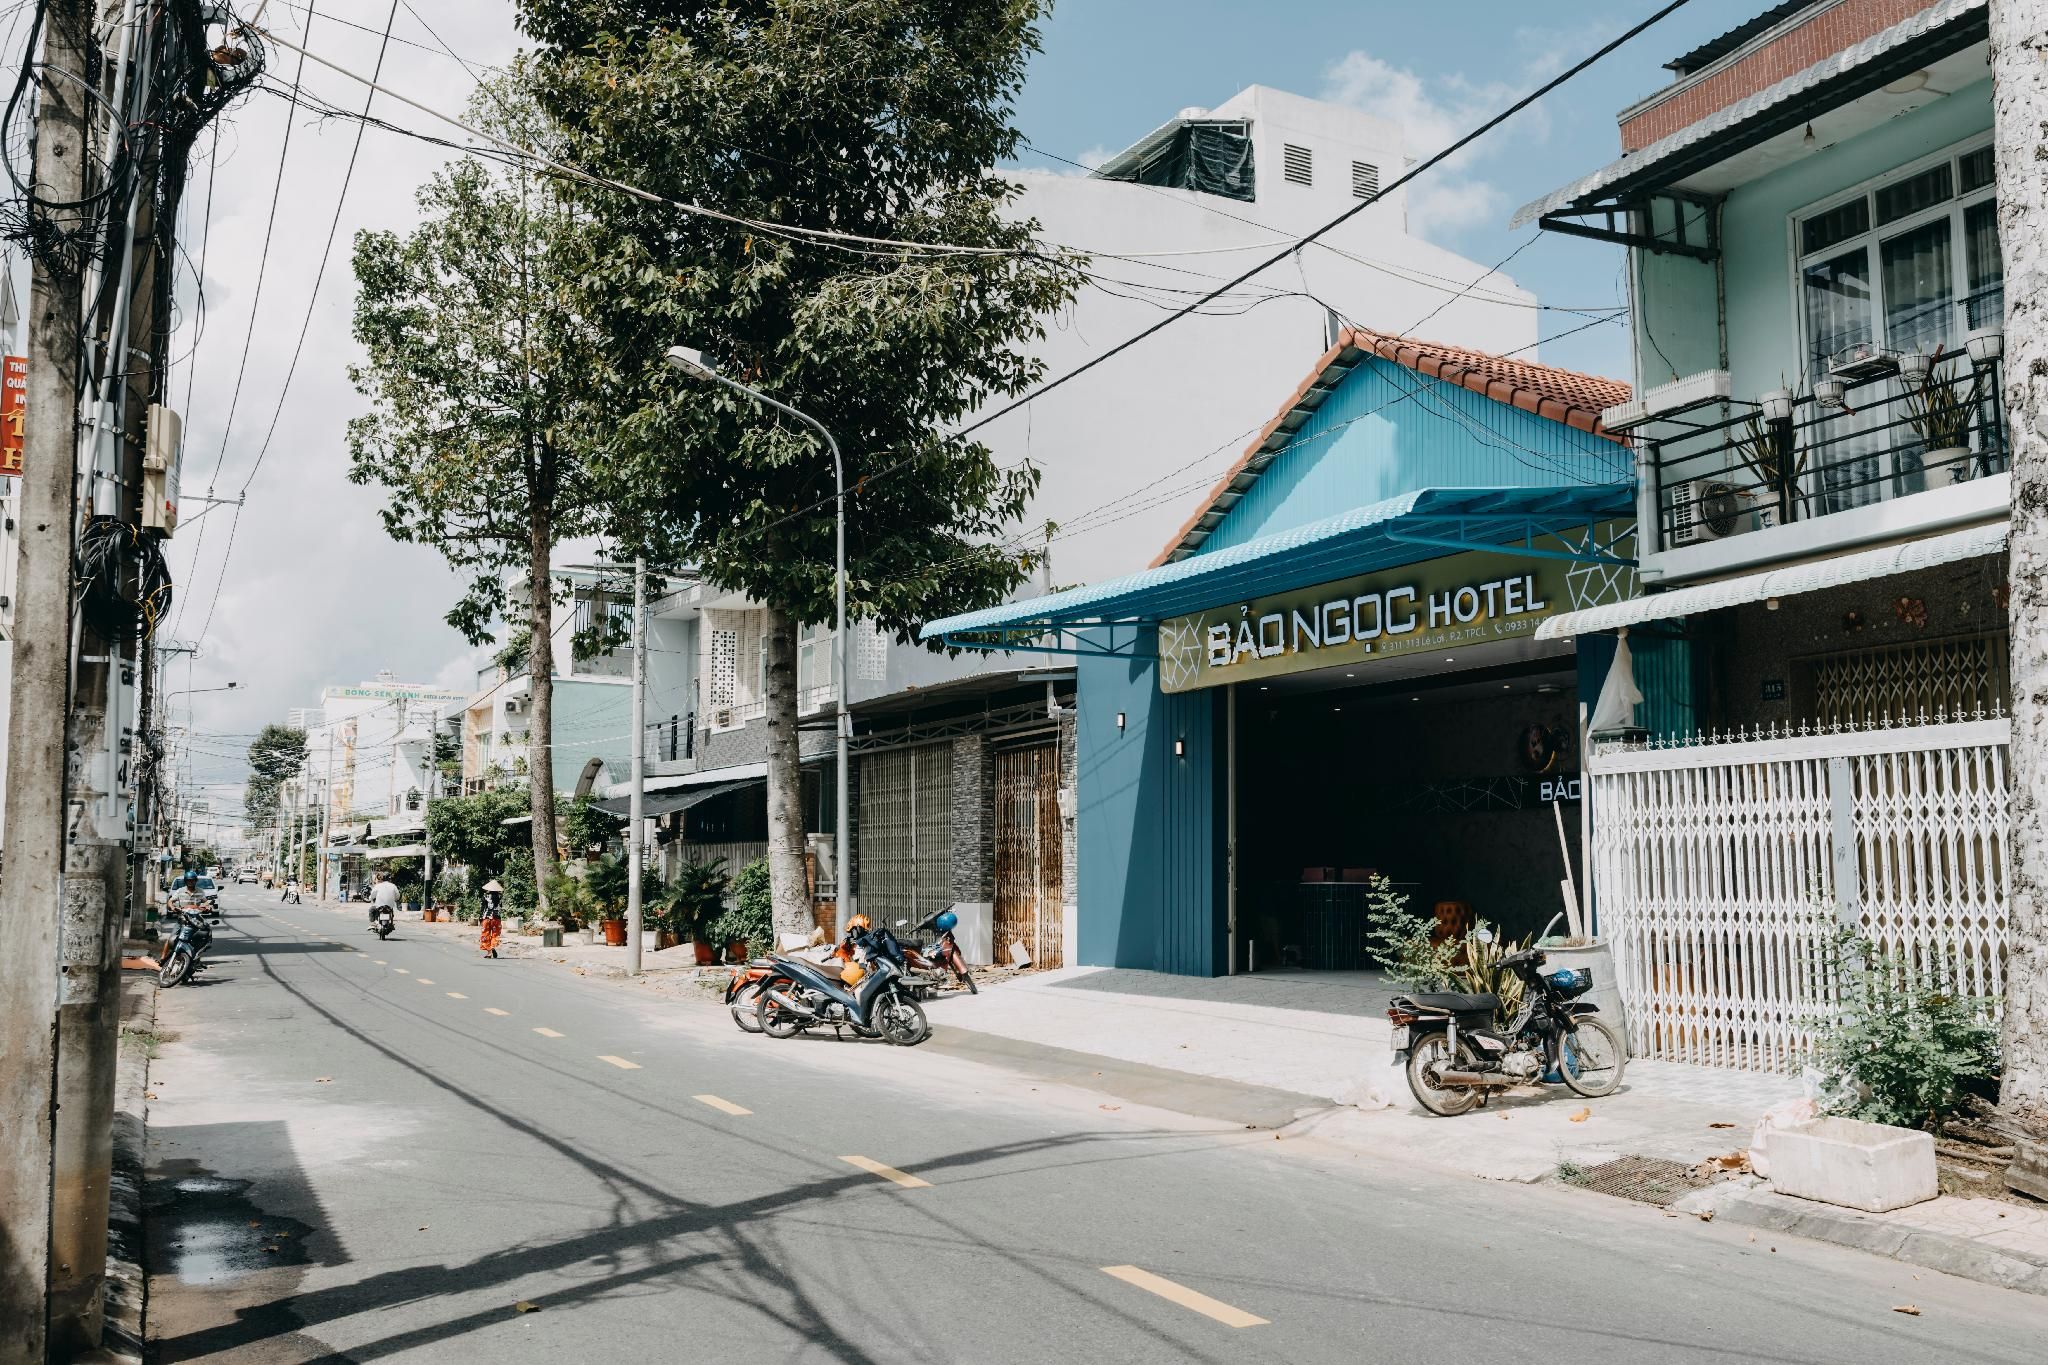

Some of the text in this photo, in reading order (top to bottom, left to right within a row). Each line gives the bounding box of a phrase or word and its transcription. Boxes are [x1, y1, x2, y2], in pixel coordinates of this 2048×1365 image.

[9, 361, 28, 374] THI
[7, 413, 25, 437] T
[1207, 575, 1545, 667] BẢO NGỌC HOTEL
[1465, 627, 1487, 639] TPCL
[1505, 620, 1527, 631] 0933
[1540, 775, 1581, 801] BẢO
